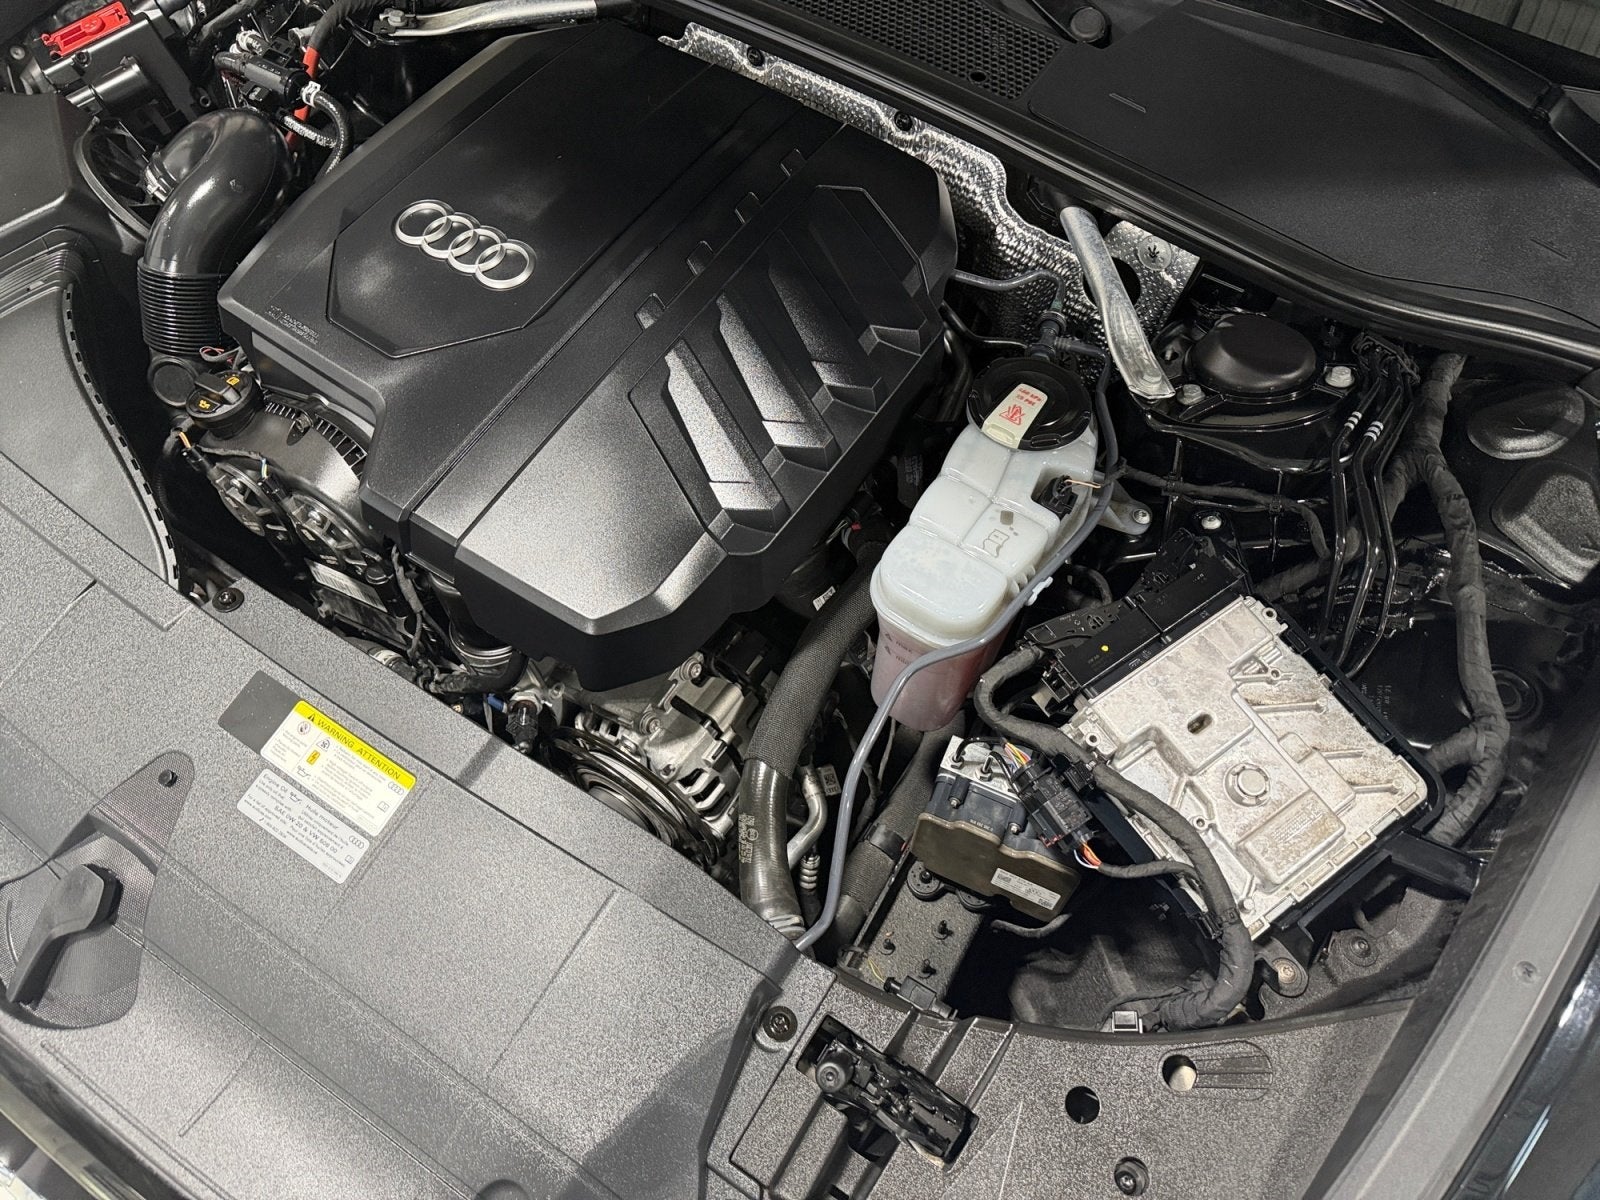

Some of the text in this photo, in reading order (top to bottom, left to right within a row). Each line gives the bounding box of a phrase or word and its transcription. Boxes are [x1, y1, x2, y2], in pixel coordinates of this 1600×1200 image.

[317, 720, 355, 749] WARNING
[356, 748, 401, 780] ATTENTION
[263, 773, 280, 788] Engine
[274, 805, 286, 816] SAE
[309, 830, 320, 840] VW
[305, 804, 340, 830] Huile moteur
